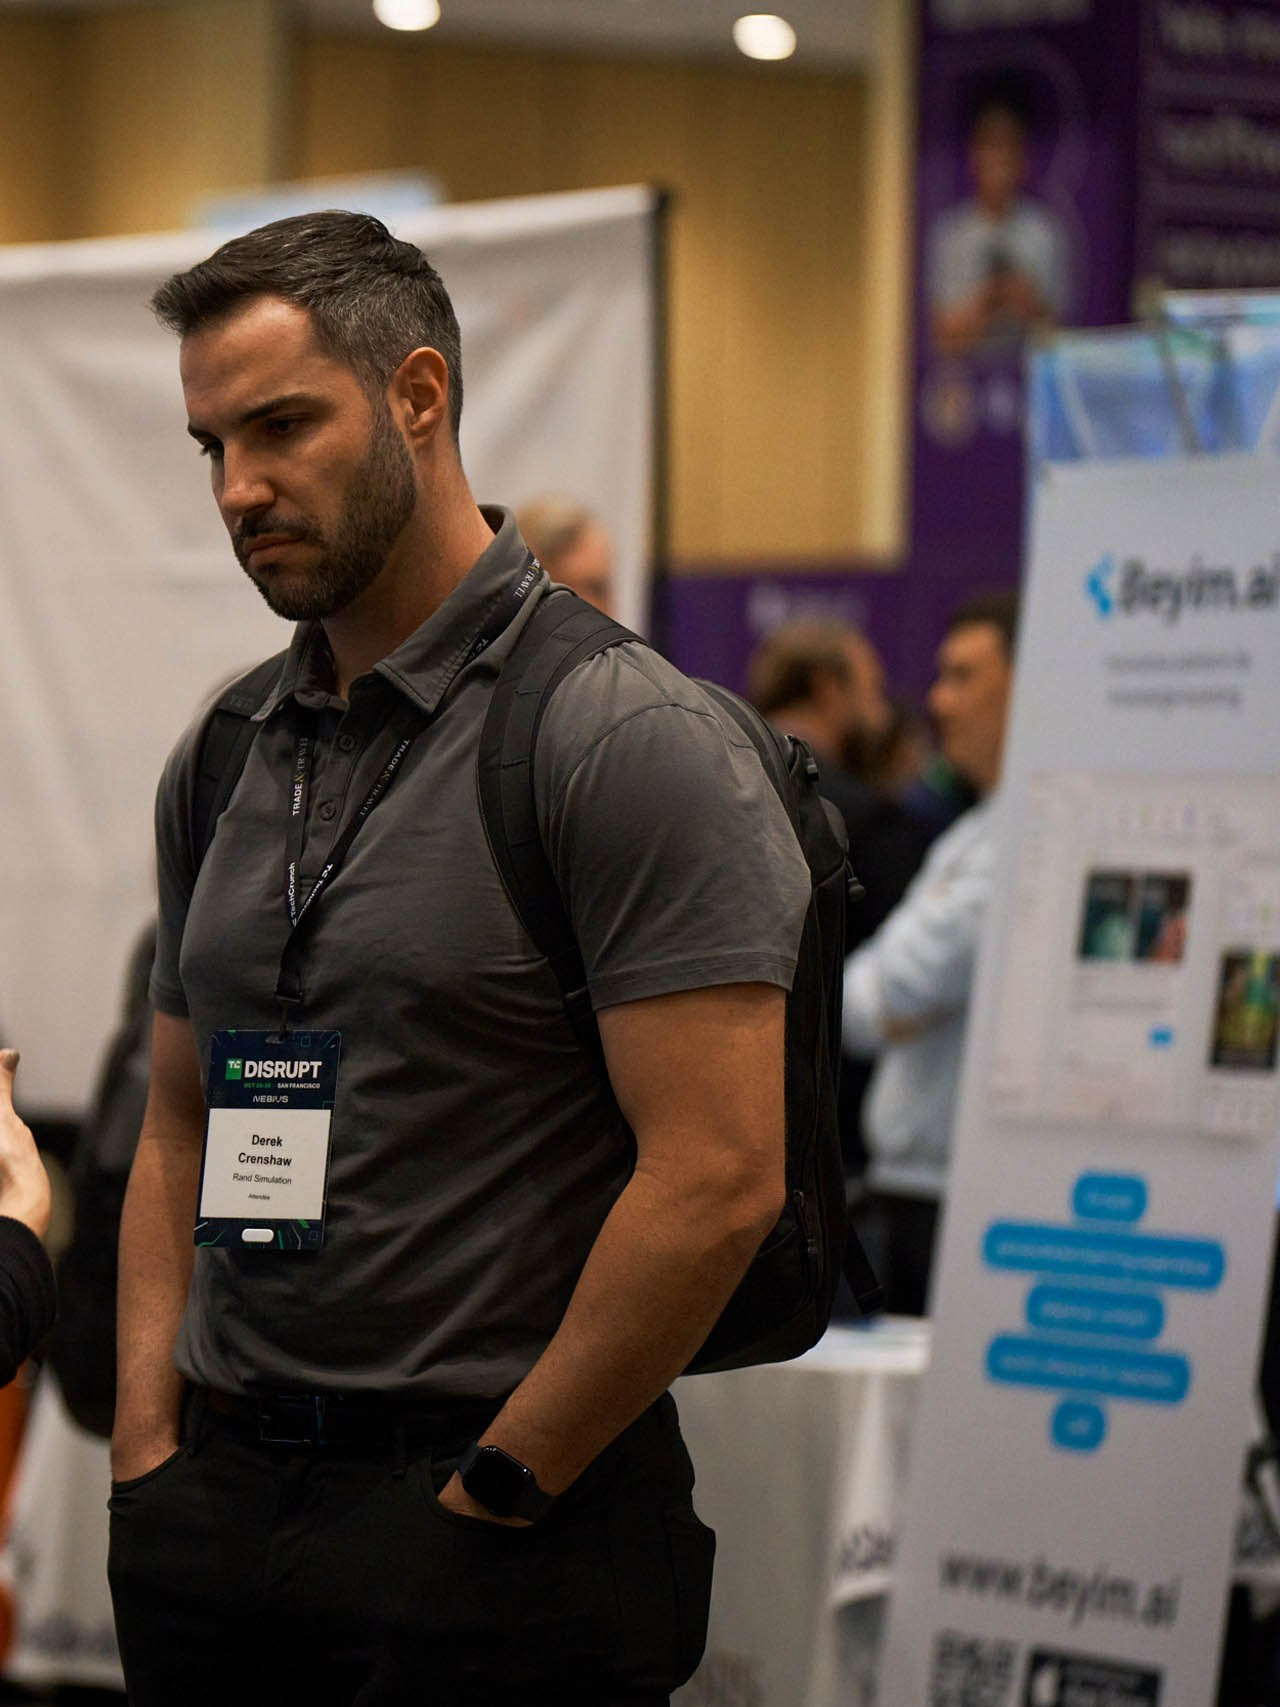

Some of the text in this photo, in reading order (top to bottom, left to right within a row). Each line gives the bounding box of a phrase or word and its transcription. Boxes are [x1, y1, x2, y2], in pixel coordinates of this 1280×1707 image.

[244, 1060, 323, 1079] DISRUPT
[252, 1095, 289, 1104] NEBIUS
[251, 1134, 283, 1147] Derek
[238, 1152, 293, 1167] Crenshaw
[232, 1172, 292, 1185] Rand Simulation
